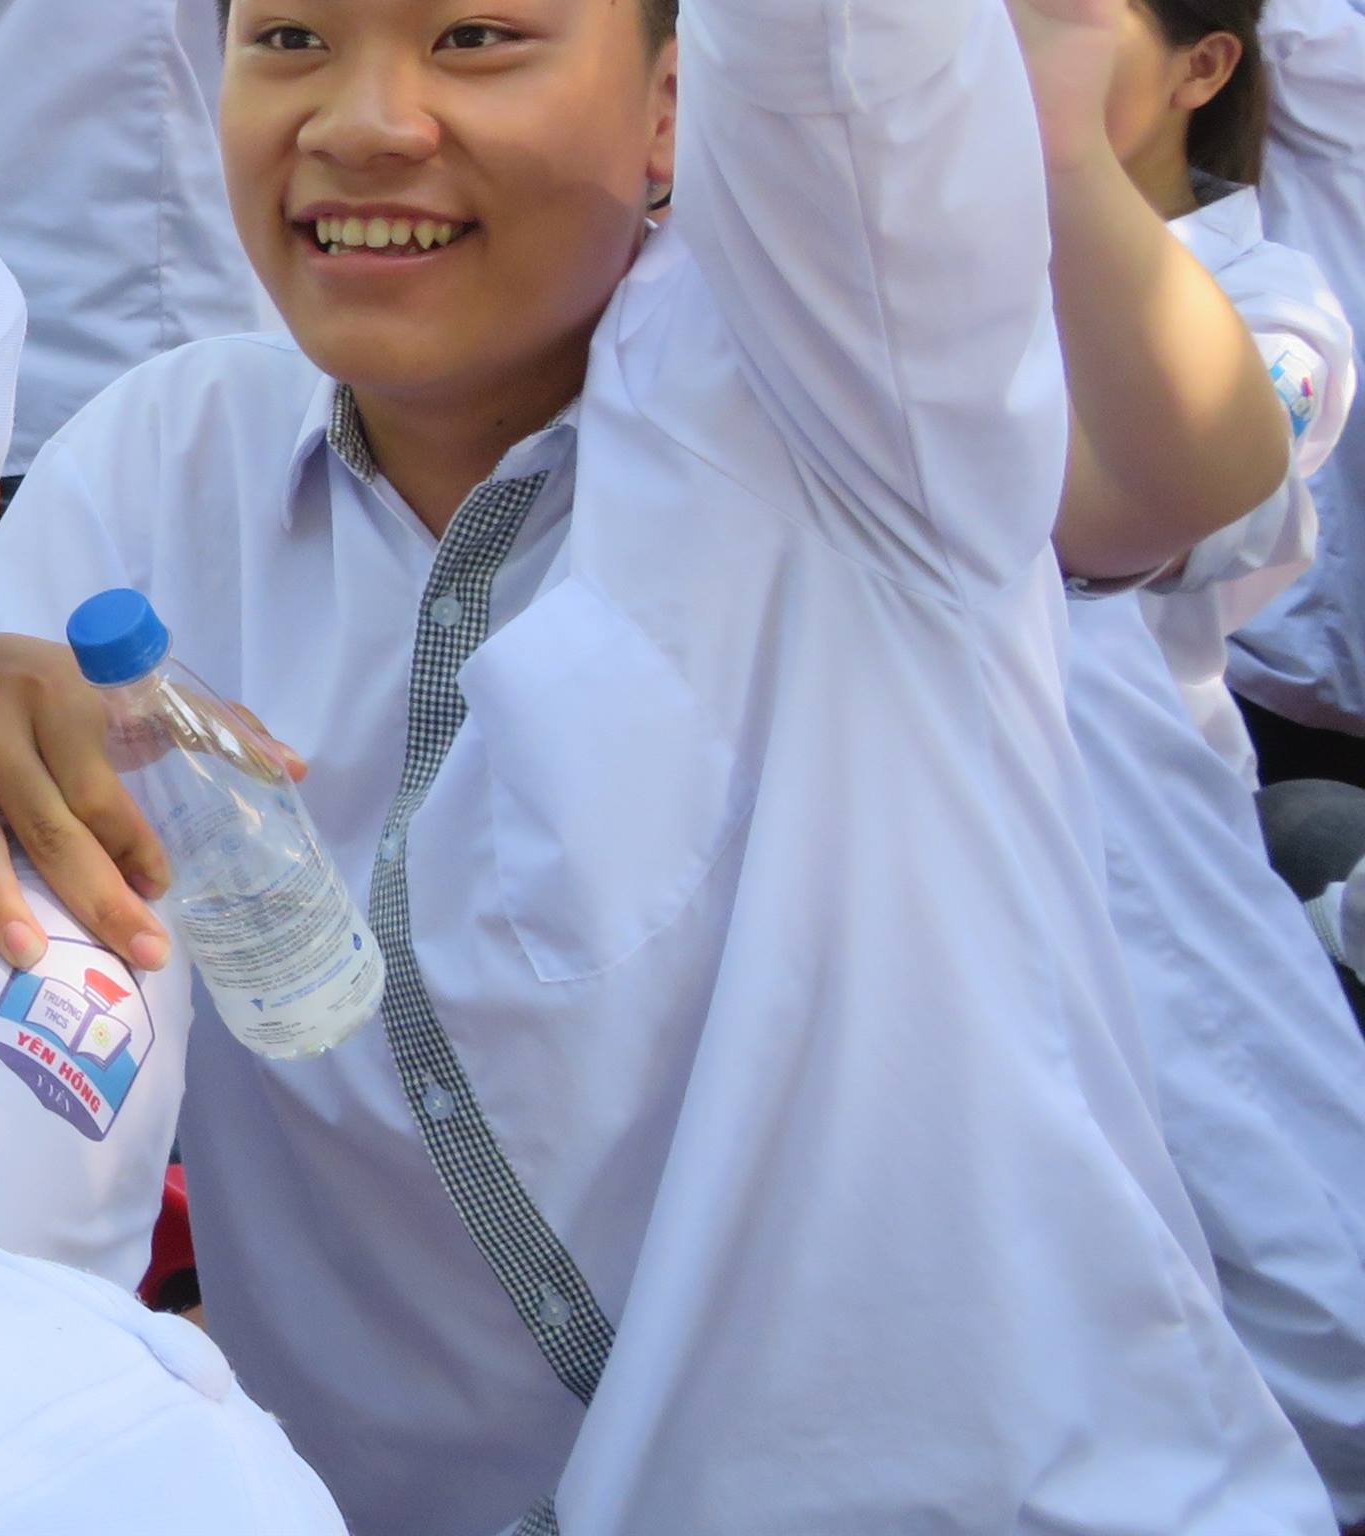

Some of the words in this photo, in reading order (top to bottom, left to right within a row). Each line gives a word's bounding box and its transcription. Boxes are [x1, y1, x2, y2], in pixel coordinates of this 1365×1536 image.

[43, 989, 83, 1022] TRƯỜNG
[44, 1006, 69, 1030] THCS
[17, 1030, 56, 1065] YÊN
